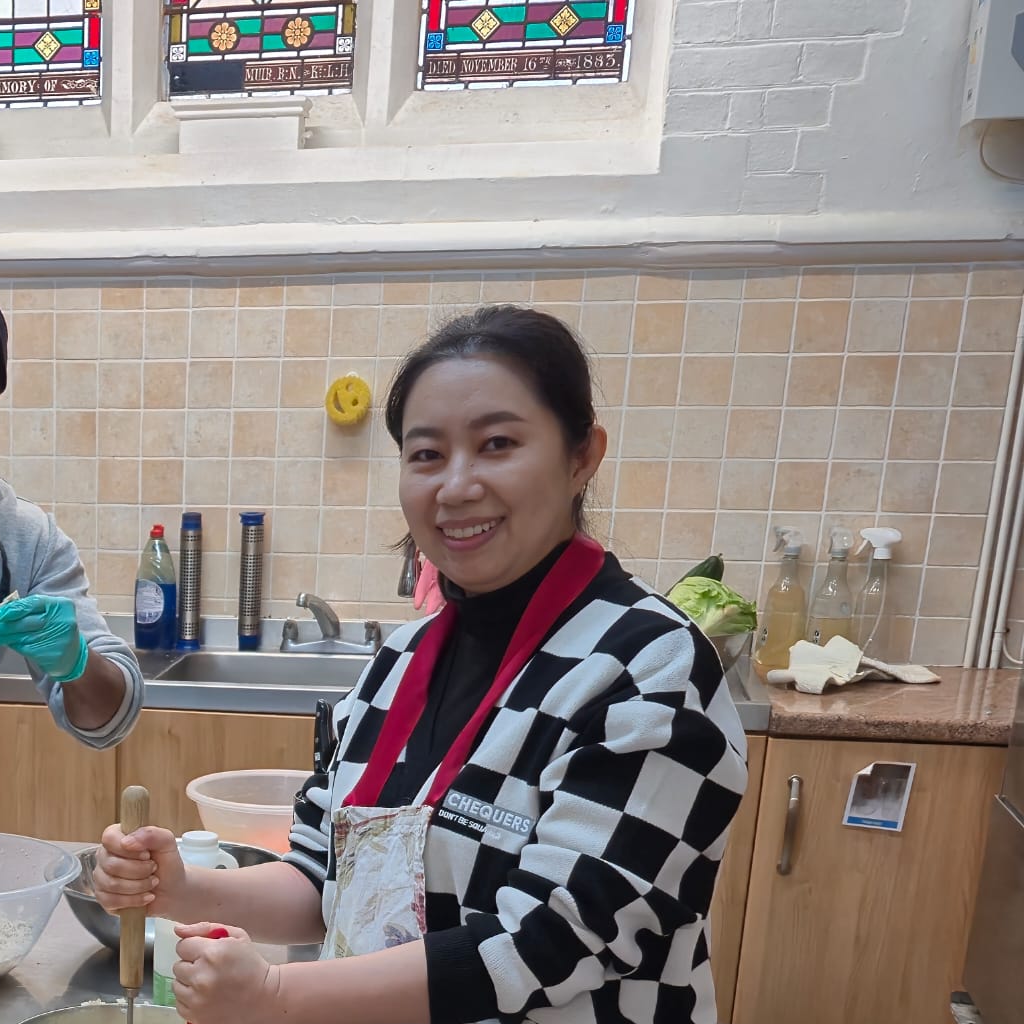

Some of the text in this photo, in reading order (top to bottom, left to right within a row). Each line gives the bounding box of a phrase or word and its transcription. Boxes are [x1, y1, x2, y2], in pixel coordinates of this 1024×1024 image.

[428, 60, 456, 75] DIED
[460, 57, 518, 73] NOVEMBER
[44, 79, 58, 92] OF
[447, 793, 531, 833] CHEQUERS
